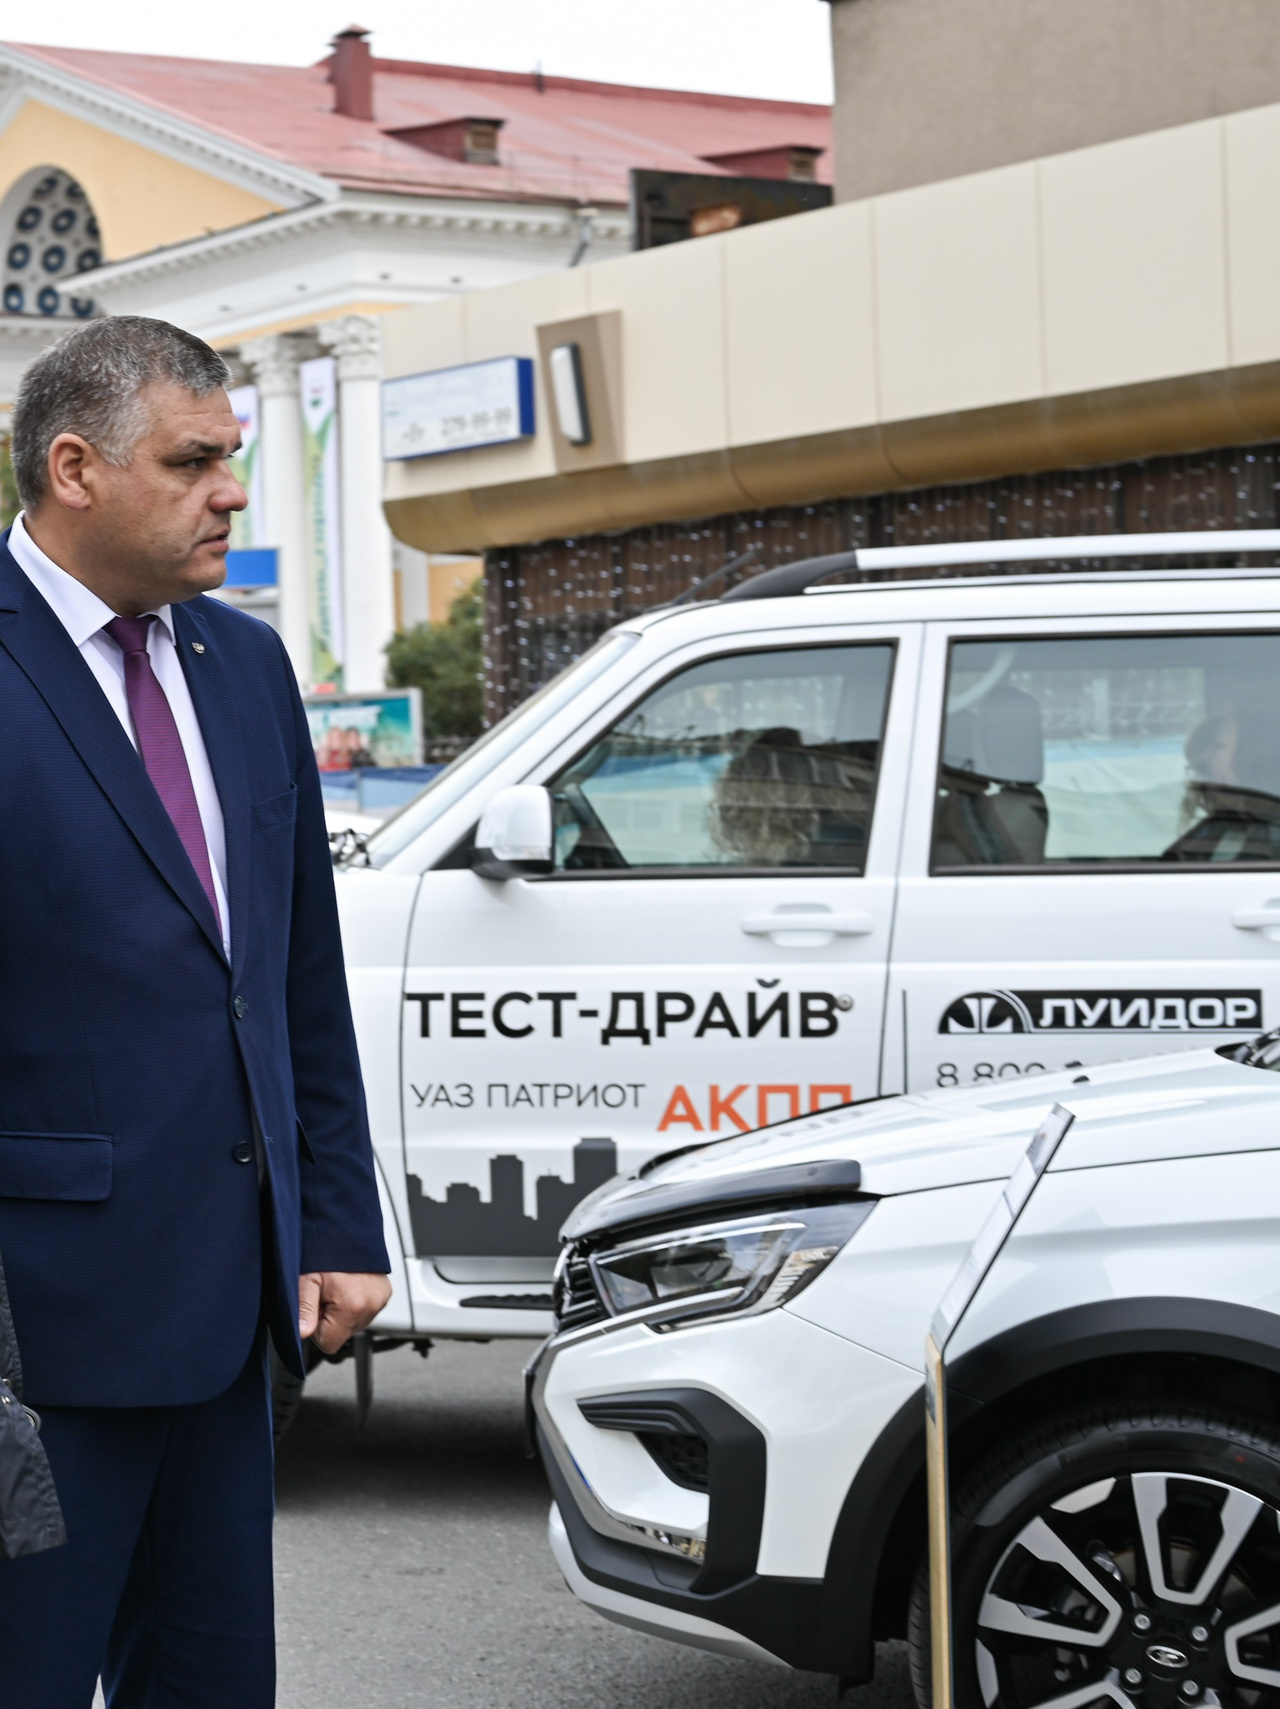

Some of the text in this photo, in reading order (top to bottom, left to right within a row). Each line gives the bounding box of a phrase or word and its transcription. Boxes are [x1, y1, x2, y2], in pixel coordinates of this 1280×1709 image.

[406, 978, 840, 1046] ТЕСТ-ДРАЙВ
[1039, 997, 1258, 1032] ЛУИДОР
[936, 1062, 959, 1088] 8
[410, 1083, 853, 1133] УАЗ ПАТРИОТ АКПП
